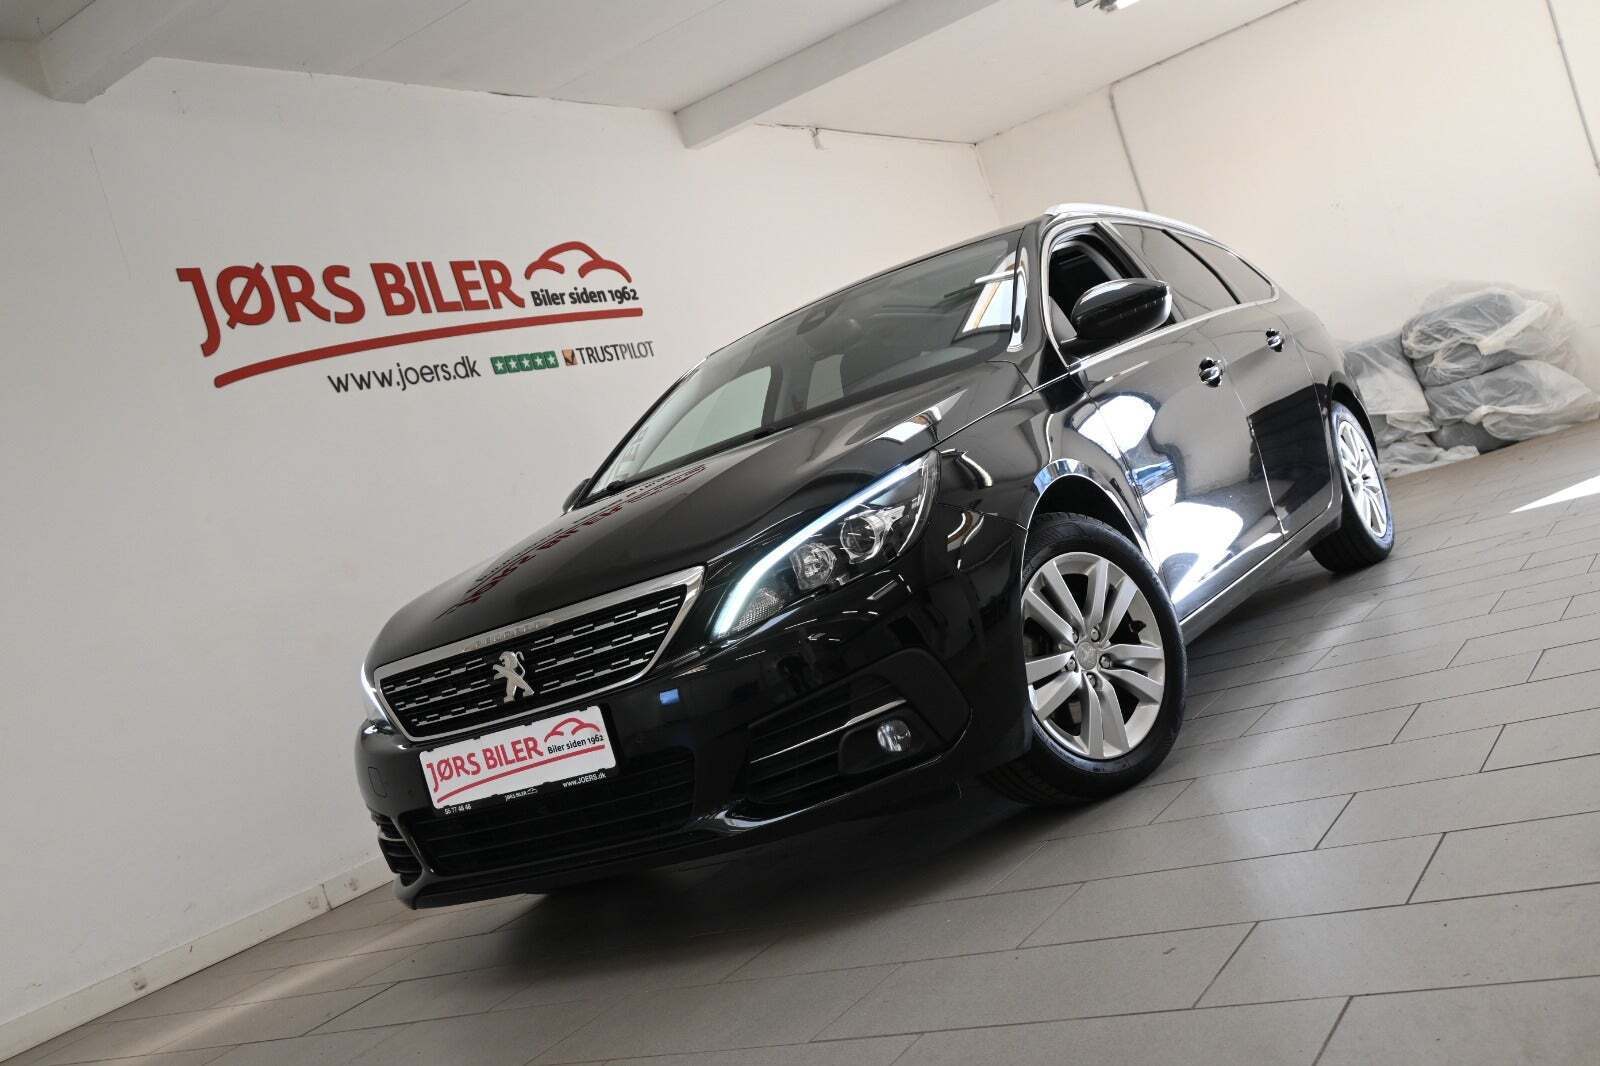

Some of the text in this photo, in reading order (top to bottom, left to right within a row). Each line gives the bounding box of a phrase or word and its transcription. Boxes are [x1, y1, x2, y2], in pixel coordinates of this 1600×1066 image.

[176, 259, 525, 358] JØRS BILER
[530, 286, 639, 307] Biler siden 1962
[576, 341, 654, 364] TRUSTPILOT
[327, 356, 482, 392] www.joers.dk
[547, 733, 604, 755] Biler siden 1962
[426, 737, 544, 792] JØRS BILER
